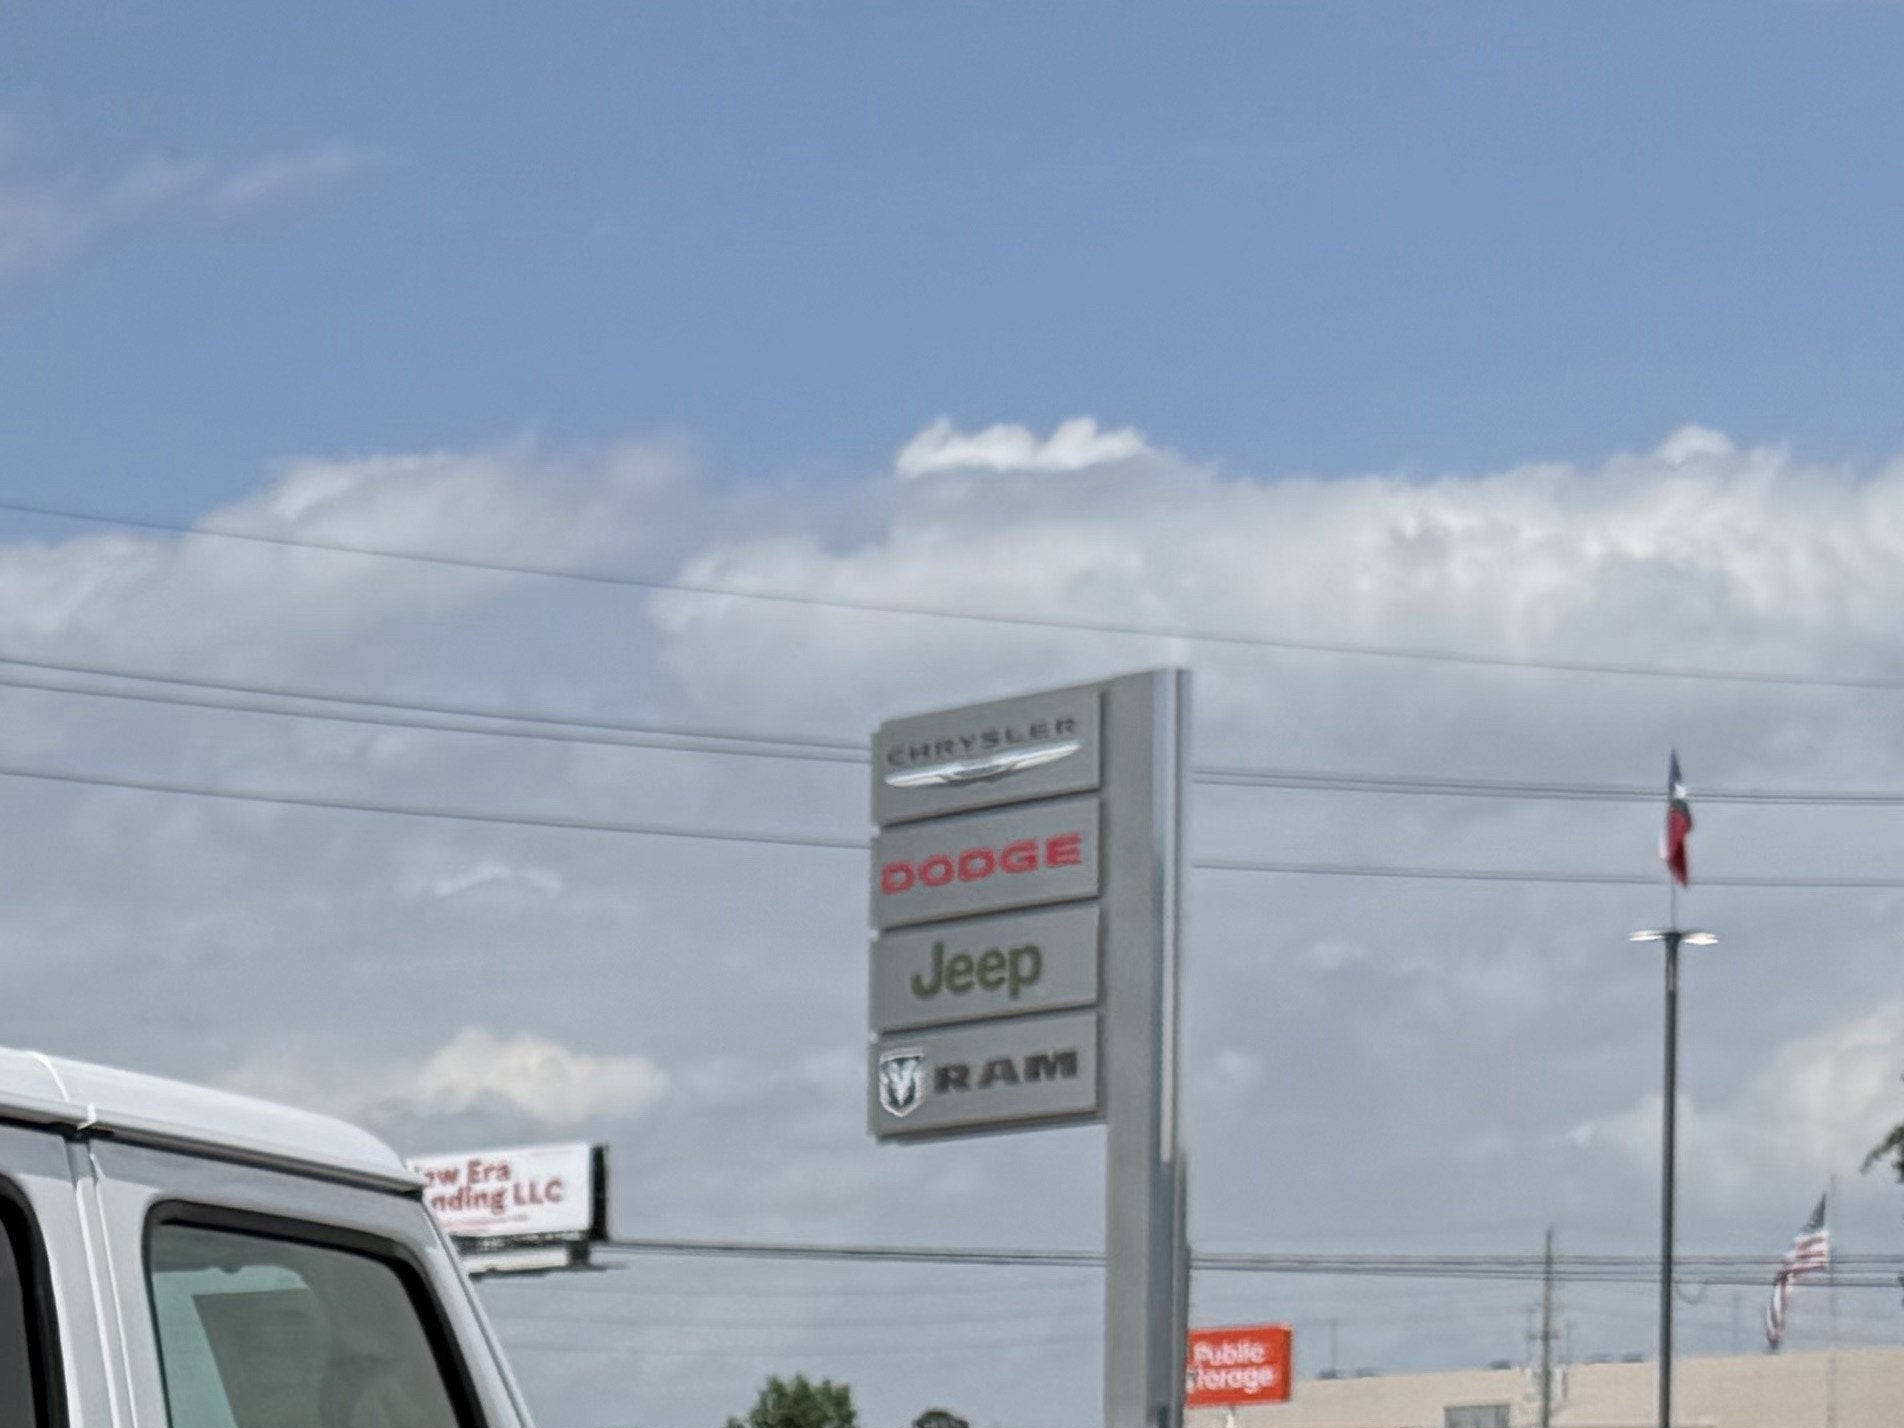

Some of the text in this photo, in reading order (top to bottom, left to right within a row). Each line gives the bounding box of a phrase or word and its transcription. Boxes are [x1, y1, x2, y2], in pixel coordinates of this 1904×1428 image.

[887, 717, 1080, 767] CHRYSLER
[881, 832, 1084, 895] DODGE
[910, 941, 1044, 1000] Jeep
[934, 1049, 1079, 1095] RAM
[468, 1158, 511, 1184] Era
[513, 1178, 563, 1206] LLC
[1193, 1339, 1266, 1366] Public
